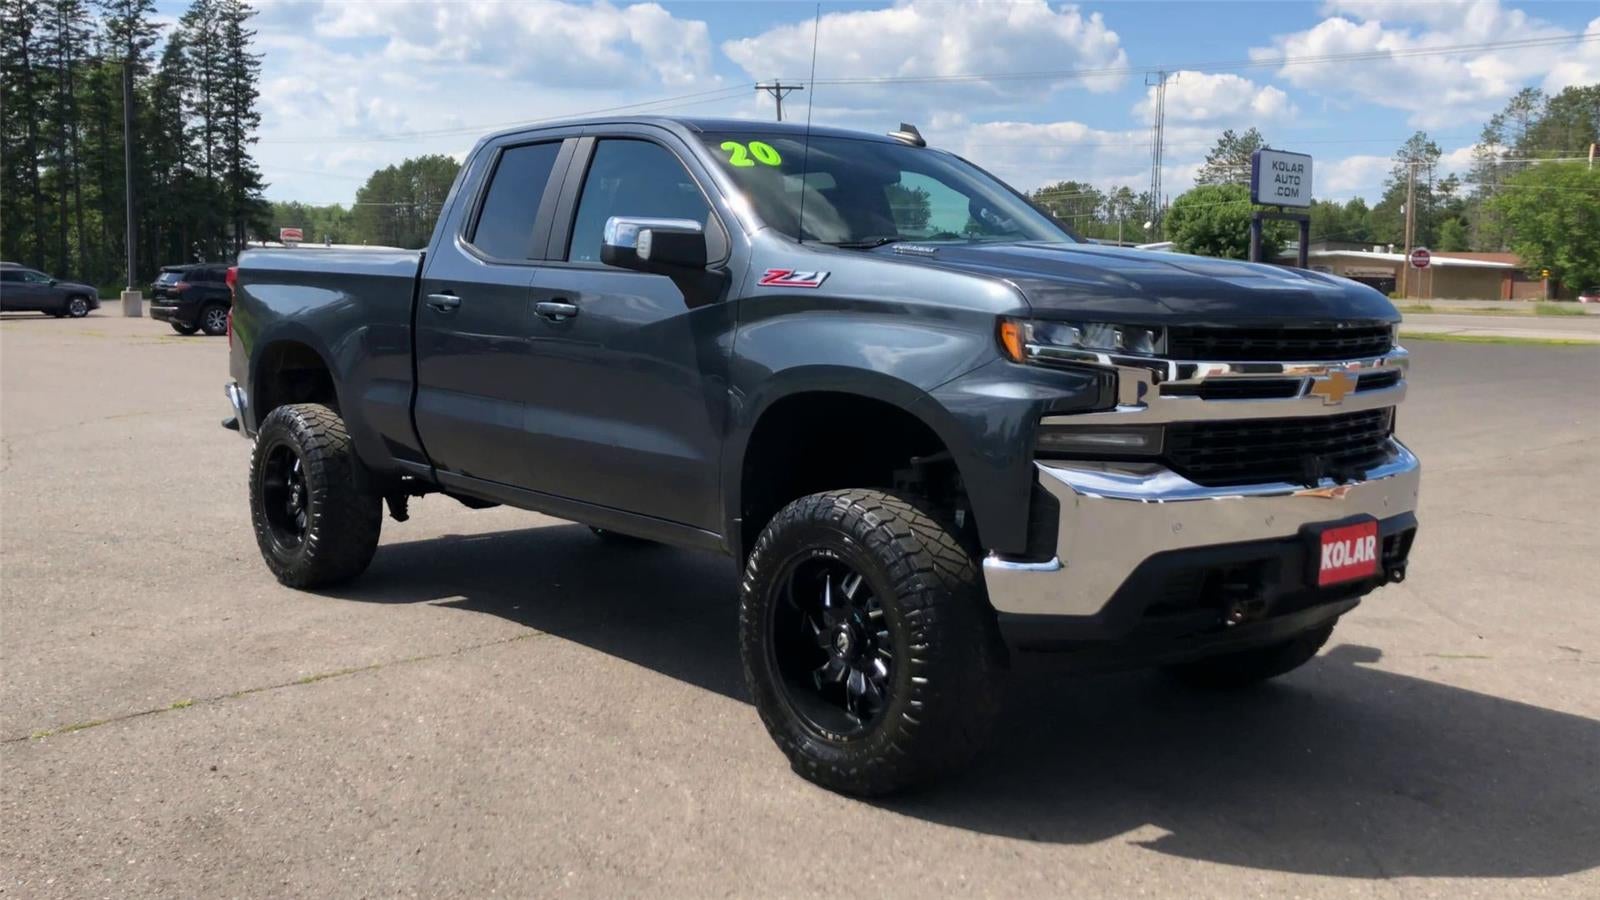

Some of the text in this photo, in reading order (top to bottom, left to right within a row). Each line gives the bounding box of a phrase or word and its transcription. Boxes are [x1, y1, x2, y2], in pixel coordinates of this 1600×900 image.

[720, 141, 781, 167] 20
[1272, 160, 1304, 173] KOLAR
[1275, 173, 1301, 185] AUTO
[1274, 186, 1300, 198] .COM
[757, 268, 831, 288] Z71
[1321, 535, 1376, 570] KOLAR
